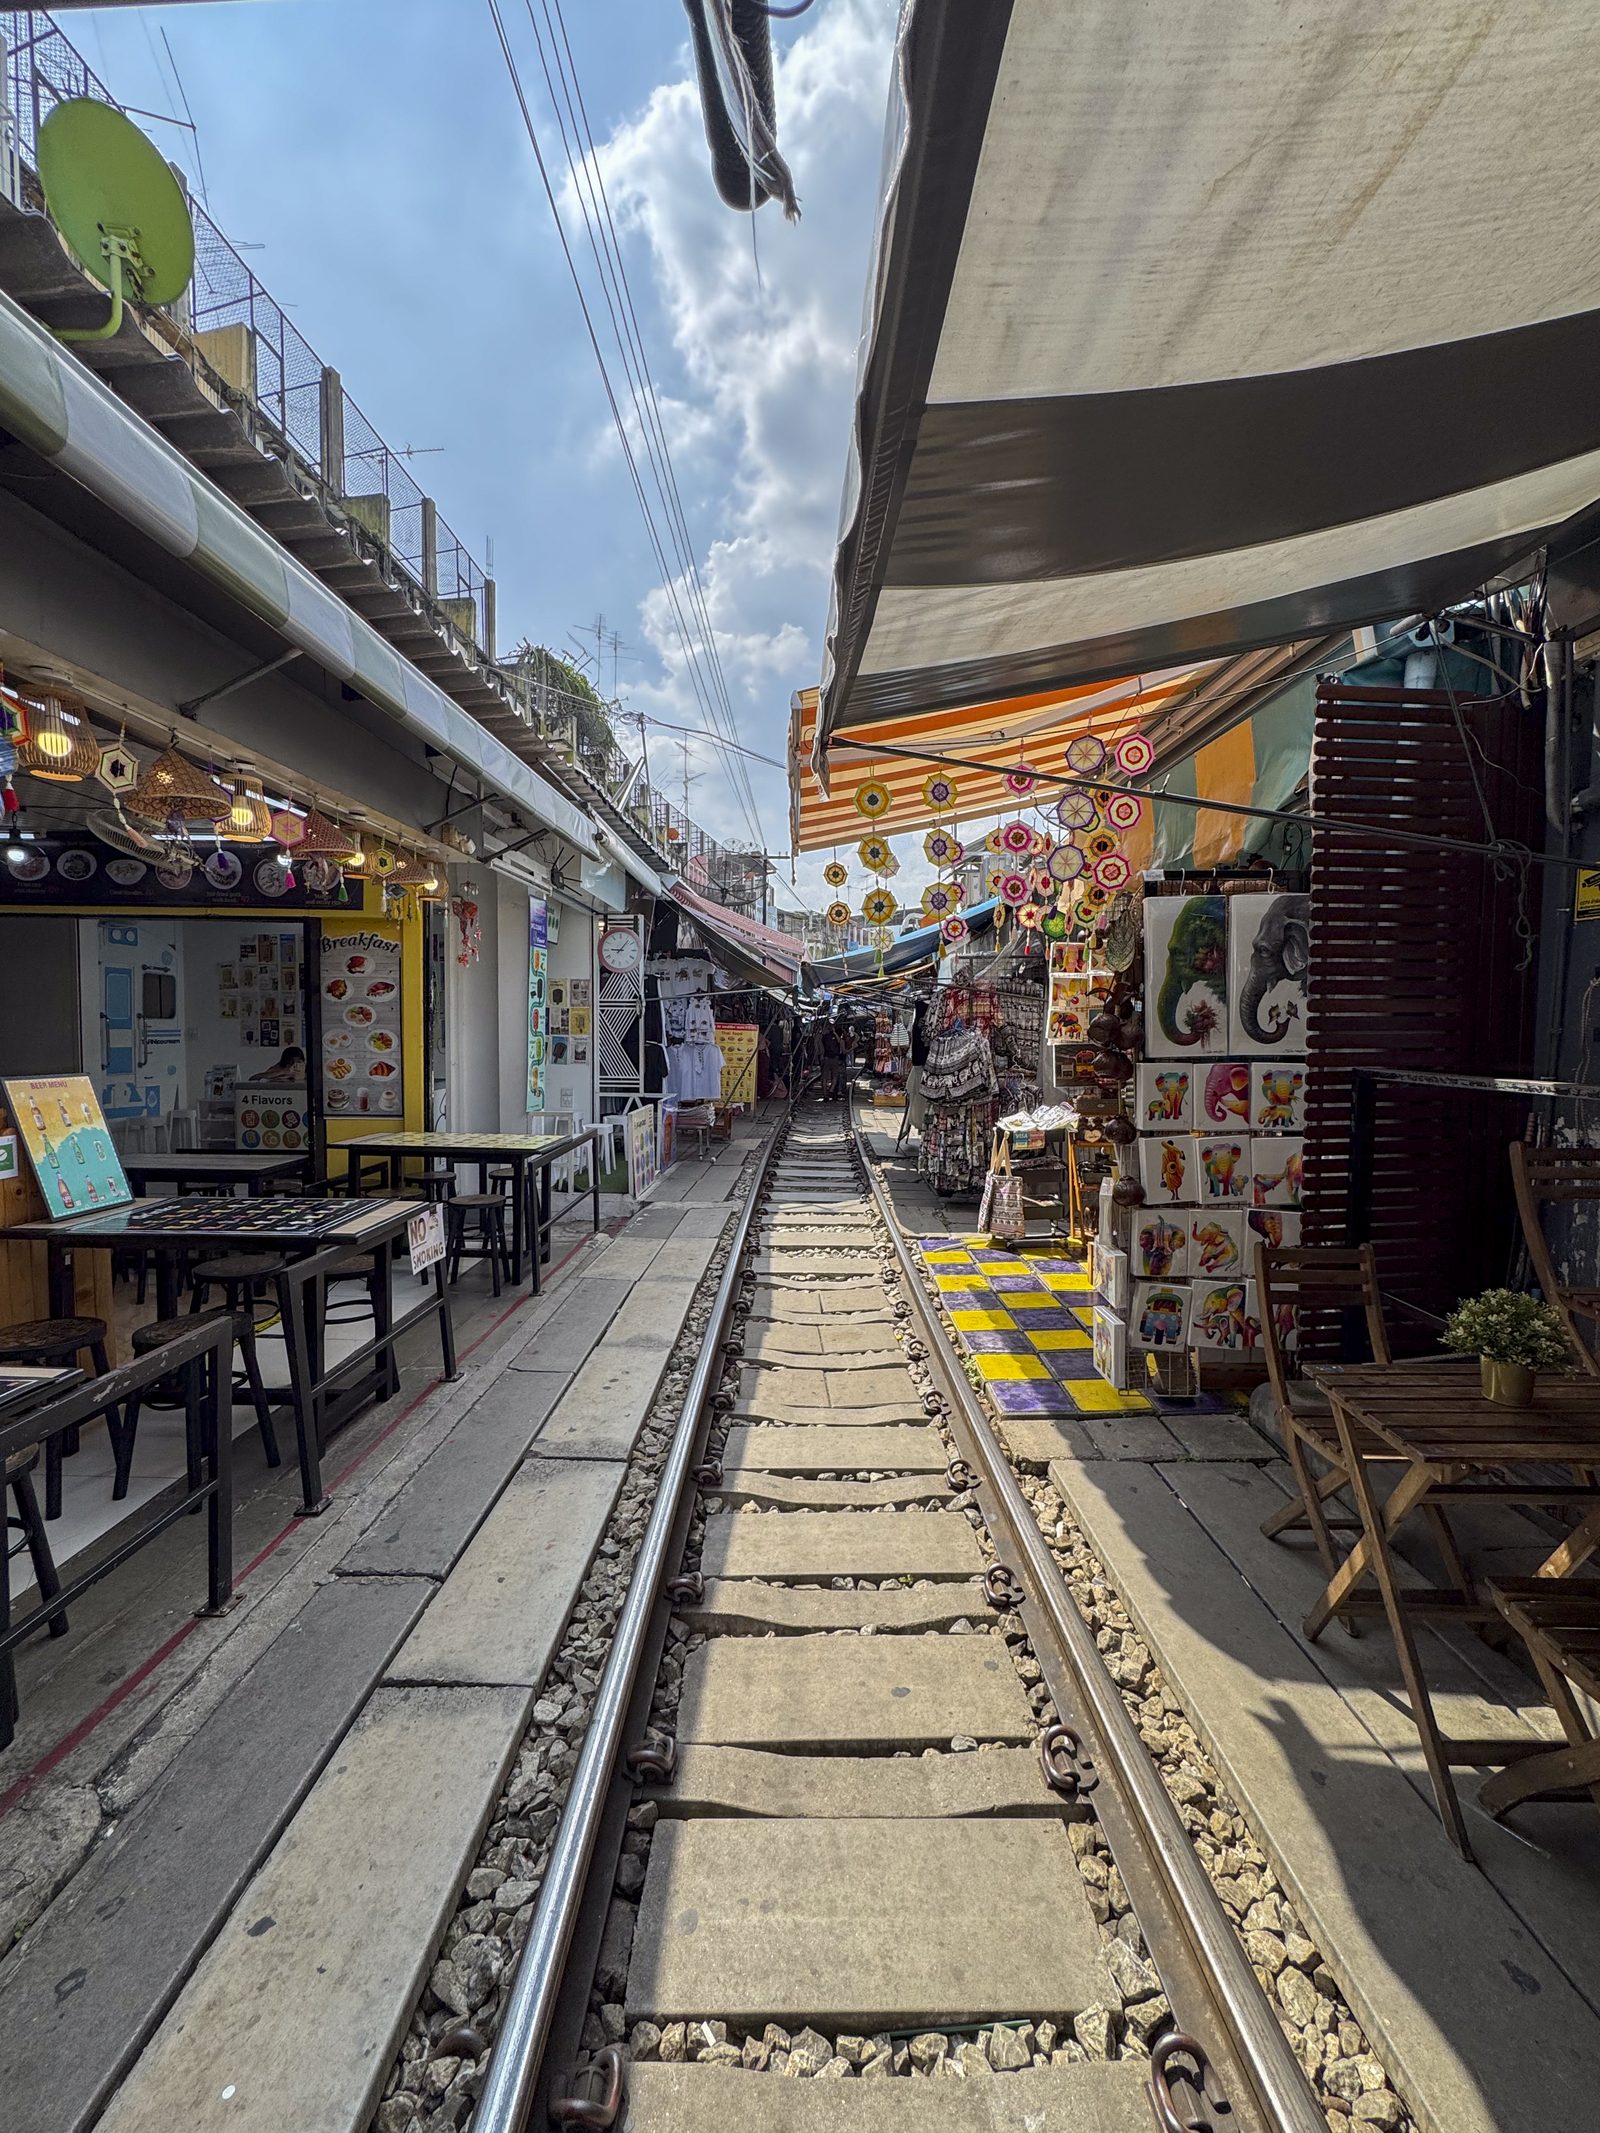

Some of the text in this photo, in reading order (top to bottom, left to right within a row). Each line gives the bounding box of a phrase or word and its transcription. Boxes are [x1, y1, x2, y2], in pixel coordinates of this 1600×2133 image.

[321, 932, 400, 953] Breakfast
[30, 1081, 48, 1090] BEER
[242, 1095, 293, 1105] 4 Flavors
[410, 1218, 426, 1246] NO
[412, 1242, 444, 1270] SMOKING
